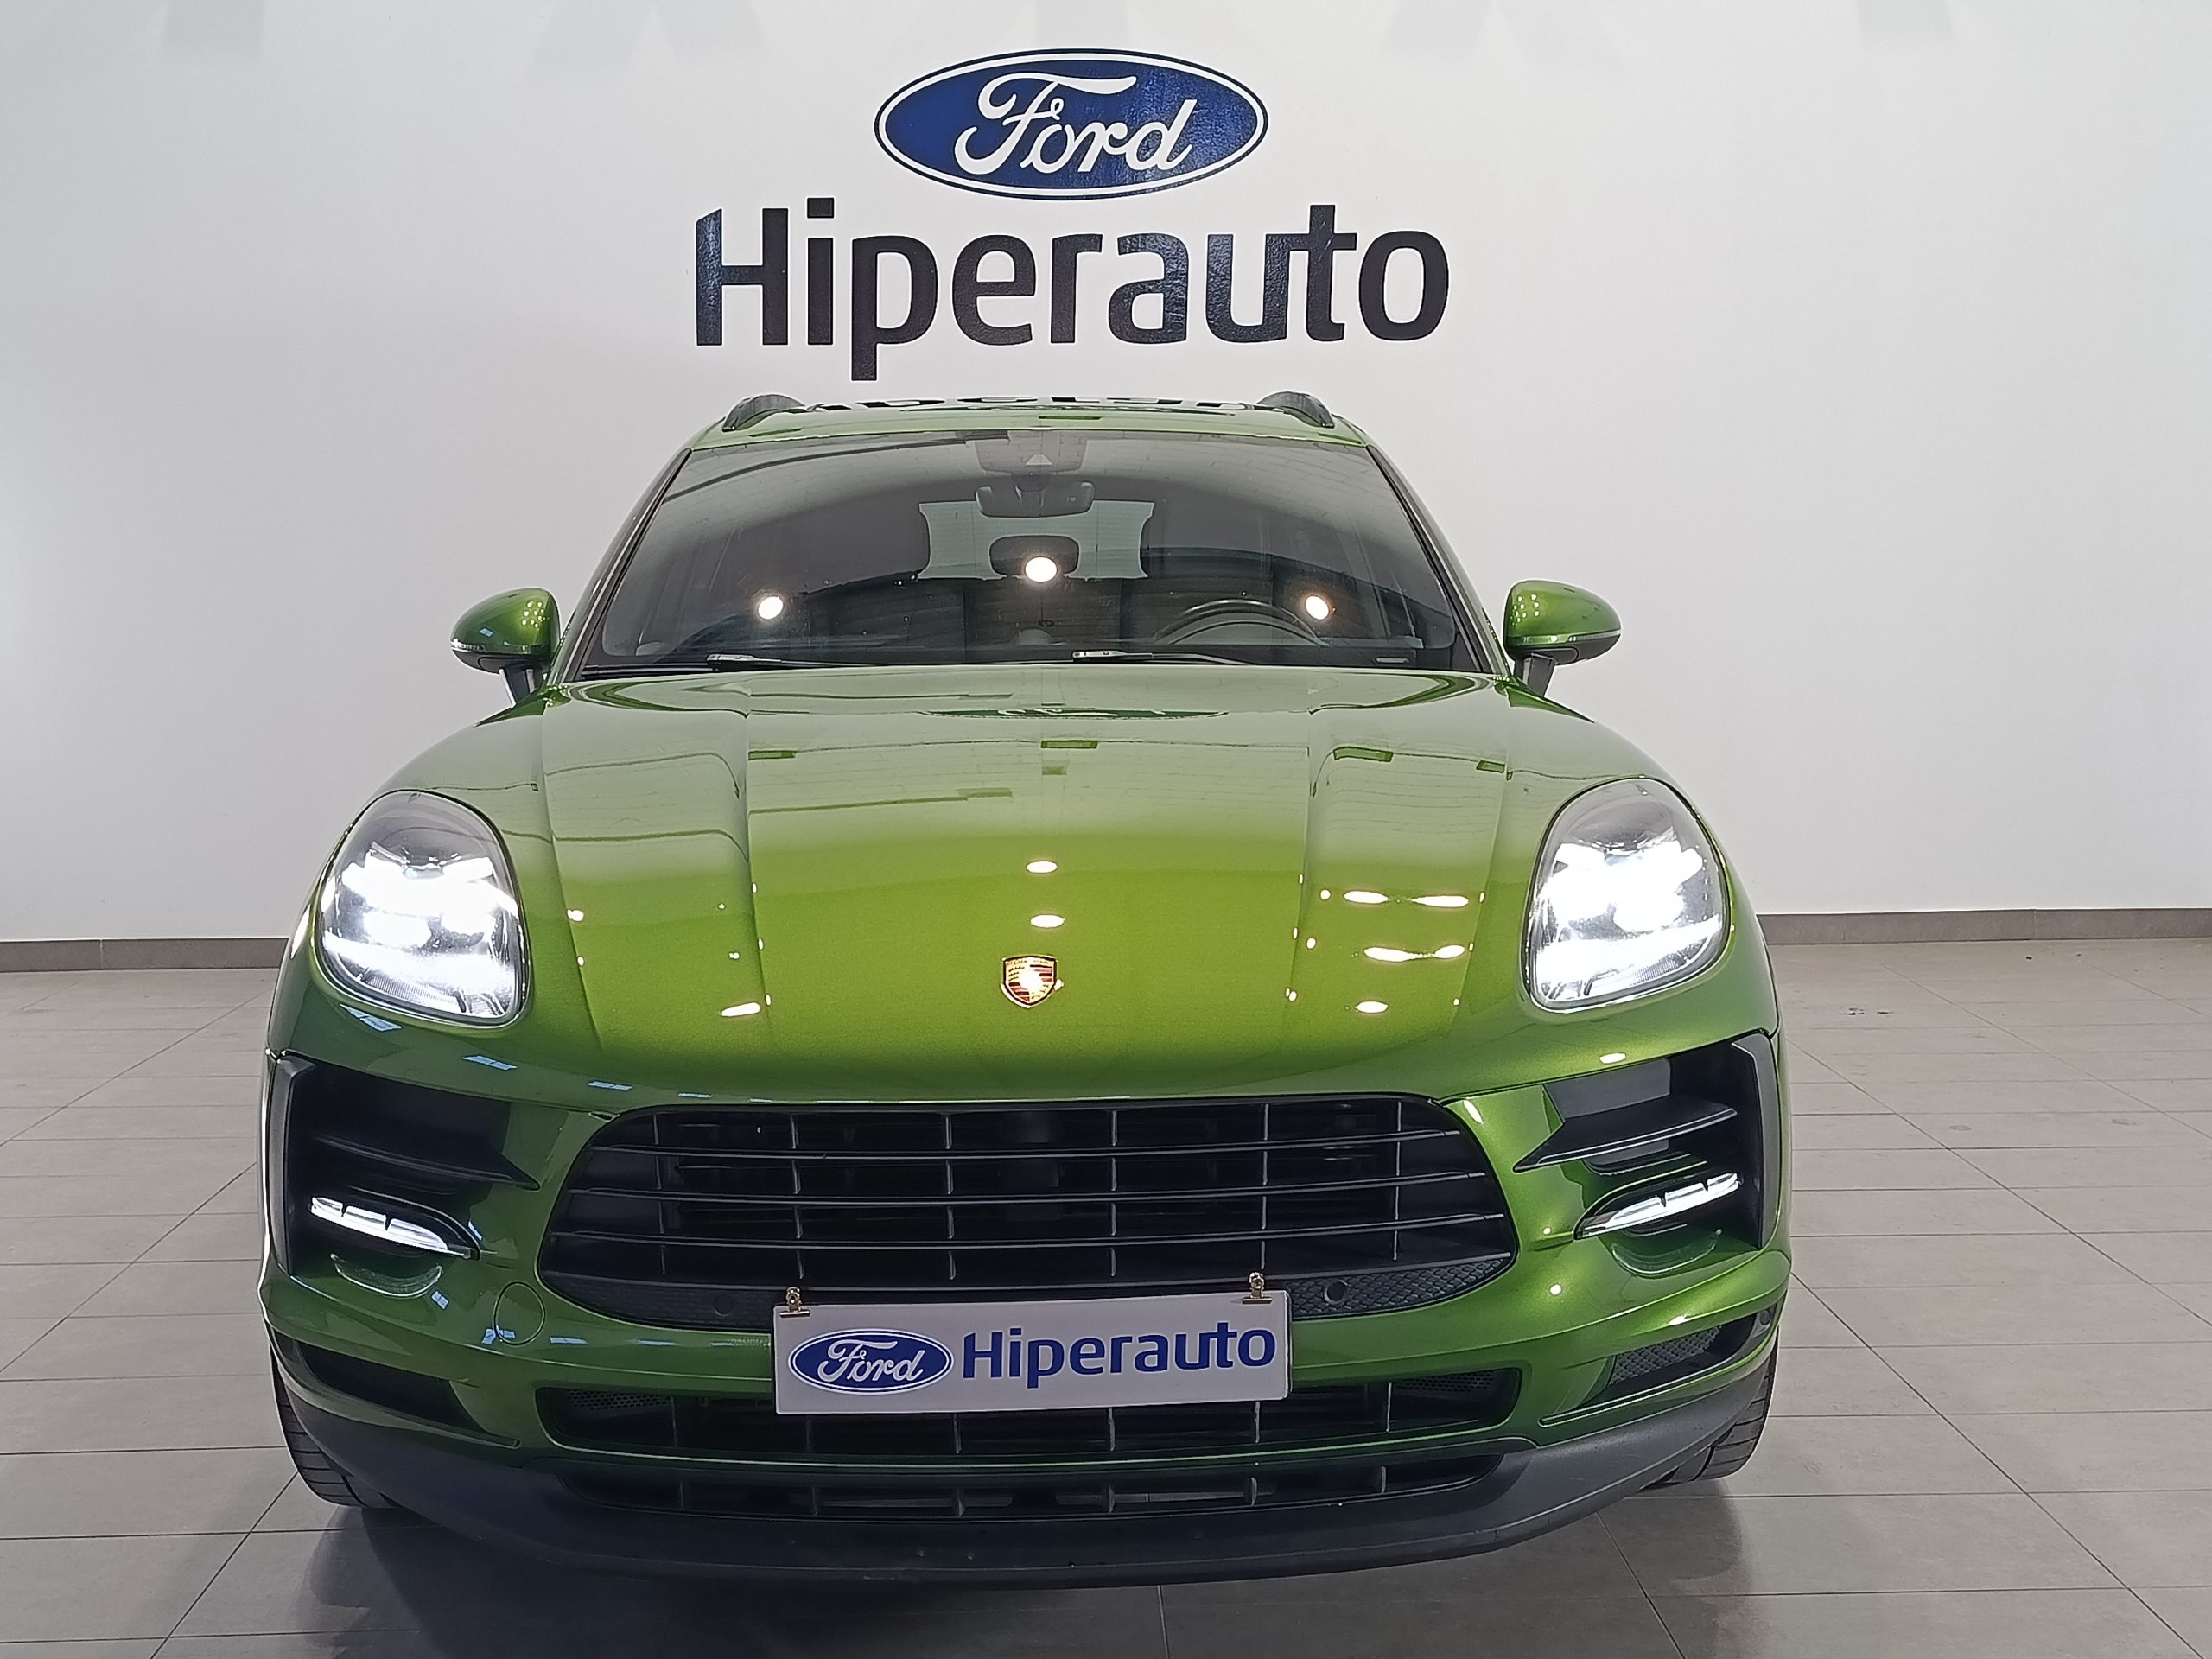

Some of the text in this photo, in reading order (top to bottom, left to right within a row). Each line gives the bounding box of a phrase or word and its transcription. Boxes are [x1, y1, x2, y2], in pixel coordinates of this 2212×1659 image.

[954, 73, 1198, 175] Ford
[696, 197, 1450, 382] Hiperauto
[817, 1321, 1276, 1389] Ford Hiperauto
